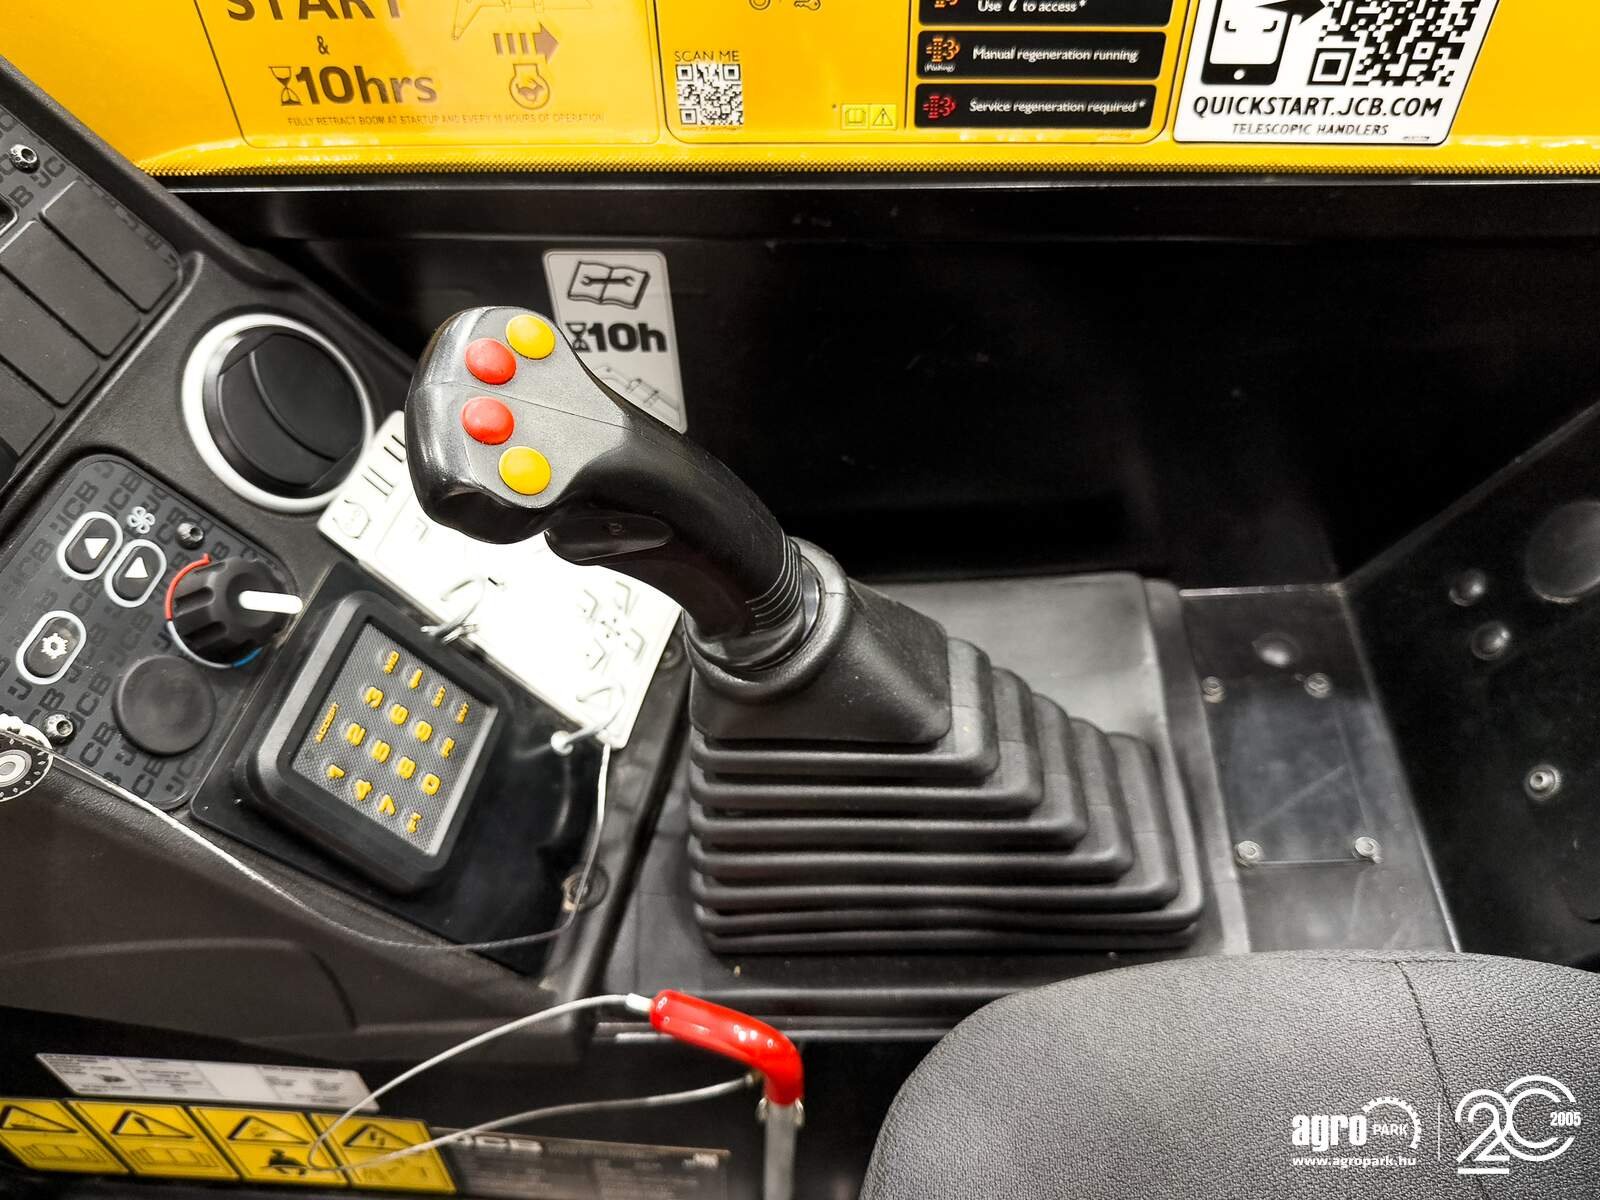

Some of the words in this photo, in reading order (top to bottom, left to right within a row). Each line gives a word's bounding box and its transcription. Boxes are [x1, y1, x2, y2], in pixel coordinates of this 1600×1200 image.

[977, 0, 1002, 12] Use
[1022, 0, 1038, 12] to
[316, 35, 330, 55] &
[972, 47, 1016, 60] Manual
[1017, 49, 1090, 63] regeneration
[1094, 50, 1139, 63] running
[674, 50, 714, 62] SCAN
[720, 50, 740, 62] ME
[296, 66, 438, 105] 10hrs
[969, 98, 1011, 112] Service
[1013, 100, 1085, 114] regeneration
[1193, 96, 1444, 117] QUICKSTART.JCB.COM
[1231, 123, 1313, 136] TELESCOPIC
[1316, 123, 1390, 136] HANDLERS
[587, 322, 668, 353] 10h
[48, 477, 99, 539] JCB
[346, 724, 367, 747] 2
[365, 687, 385, 709] 3
[355, 780, 373, 801] 4
[372, 741, 392, 764] 5
[390, 704, 410, 726] 6
[379, 795, 396, 816] 7
[398, 757, 417, 780] 8
[416, 721, 433, 743] 9
